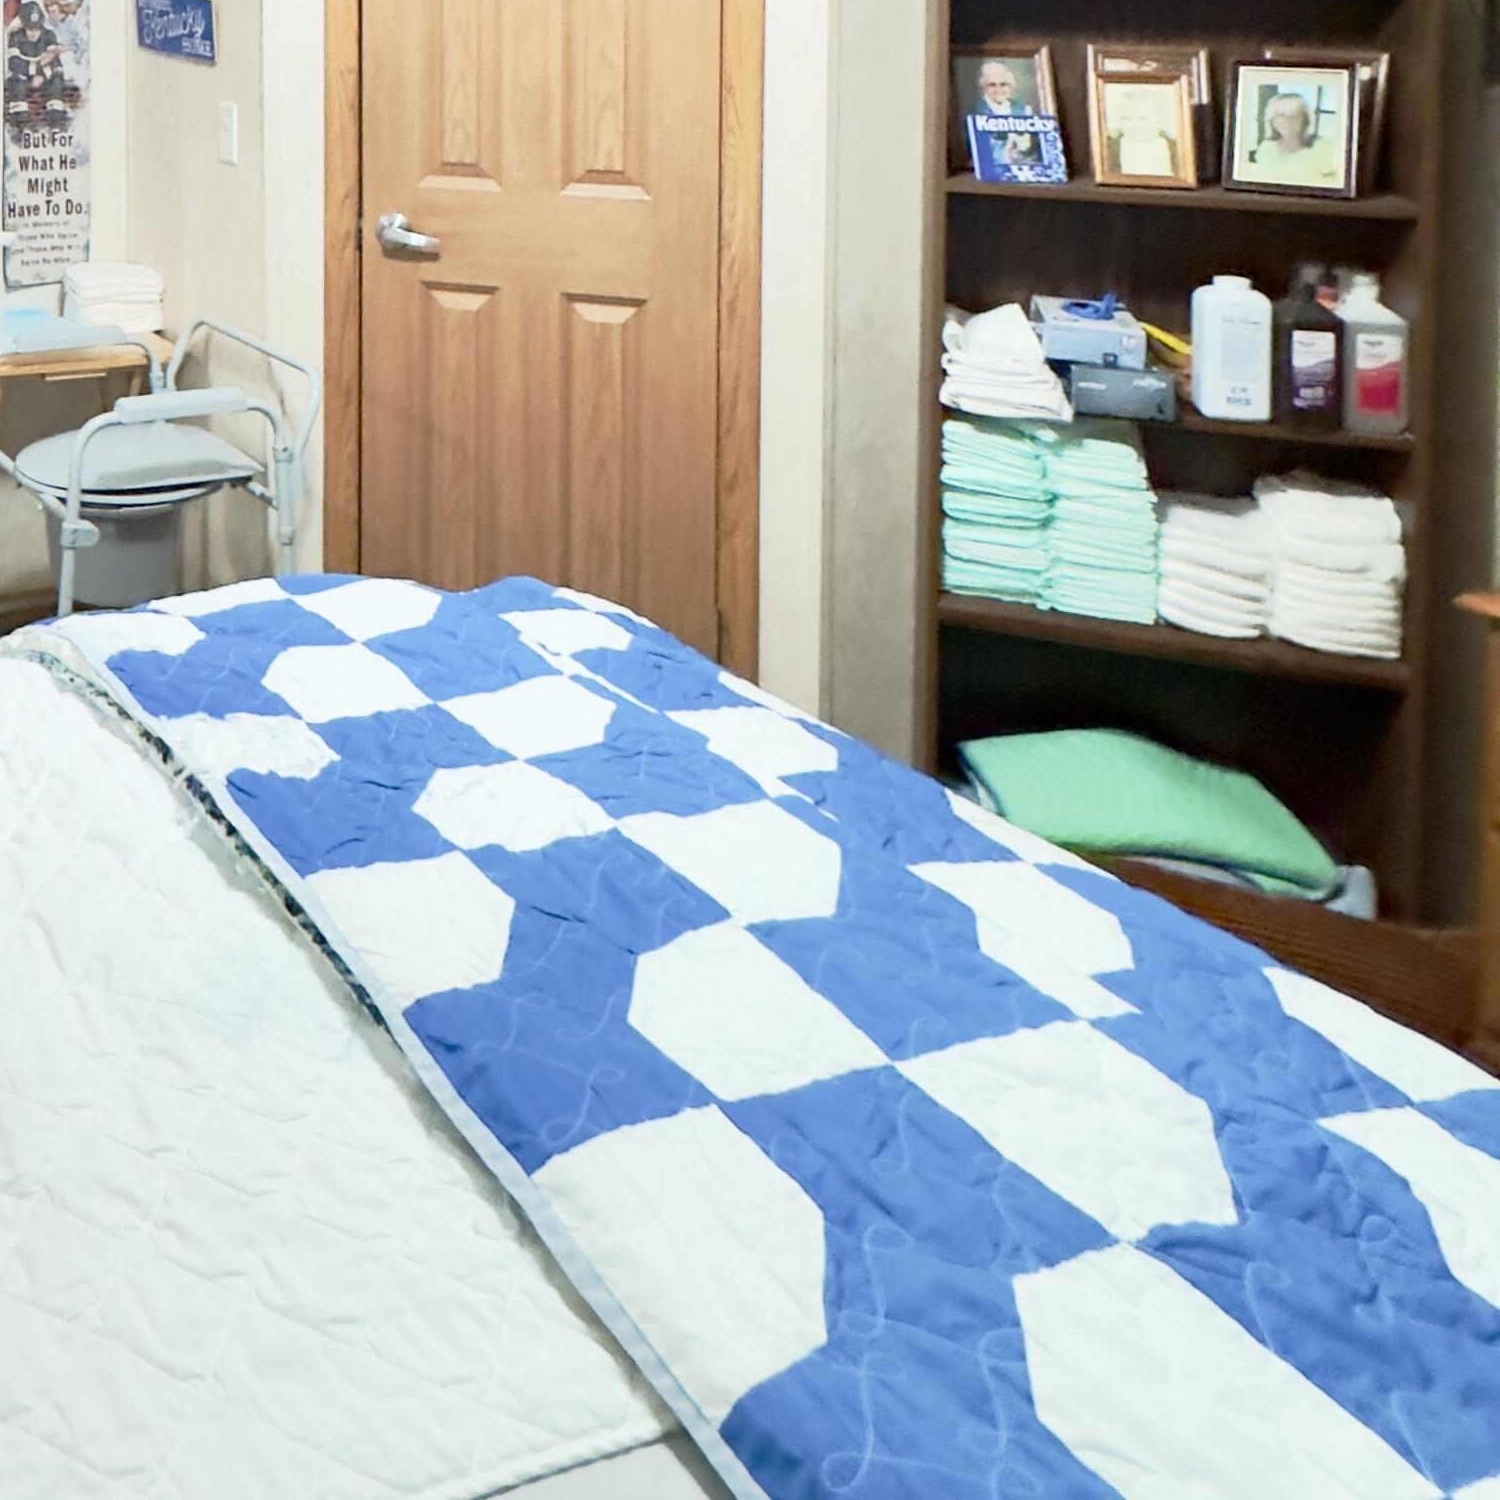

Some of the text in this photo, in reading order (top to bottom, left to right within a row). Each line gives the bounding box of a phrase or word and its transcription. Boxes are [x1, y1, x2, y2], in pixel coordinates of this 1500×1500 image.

[23, 131, 73, 149] But For
[19, 154, 77, 172] What He
[28, 178, 68, 197] Might
[8, 202, 40, 218] Have
[45, 199, 60, 216] To
